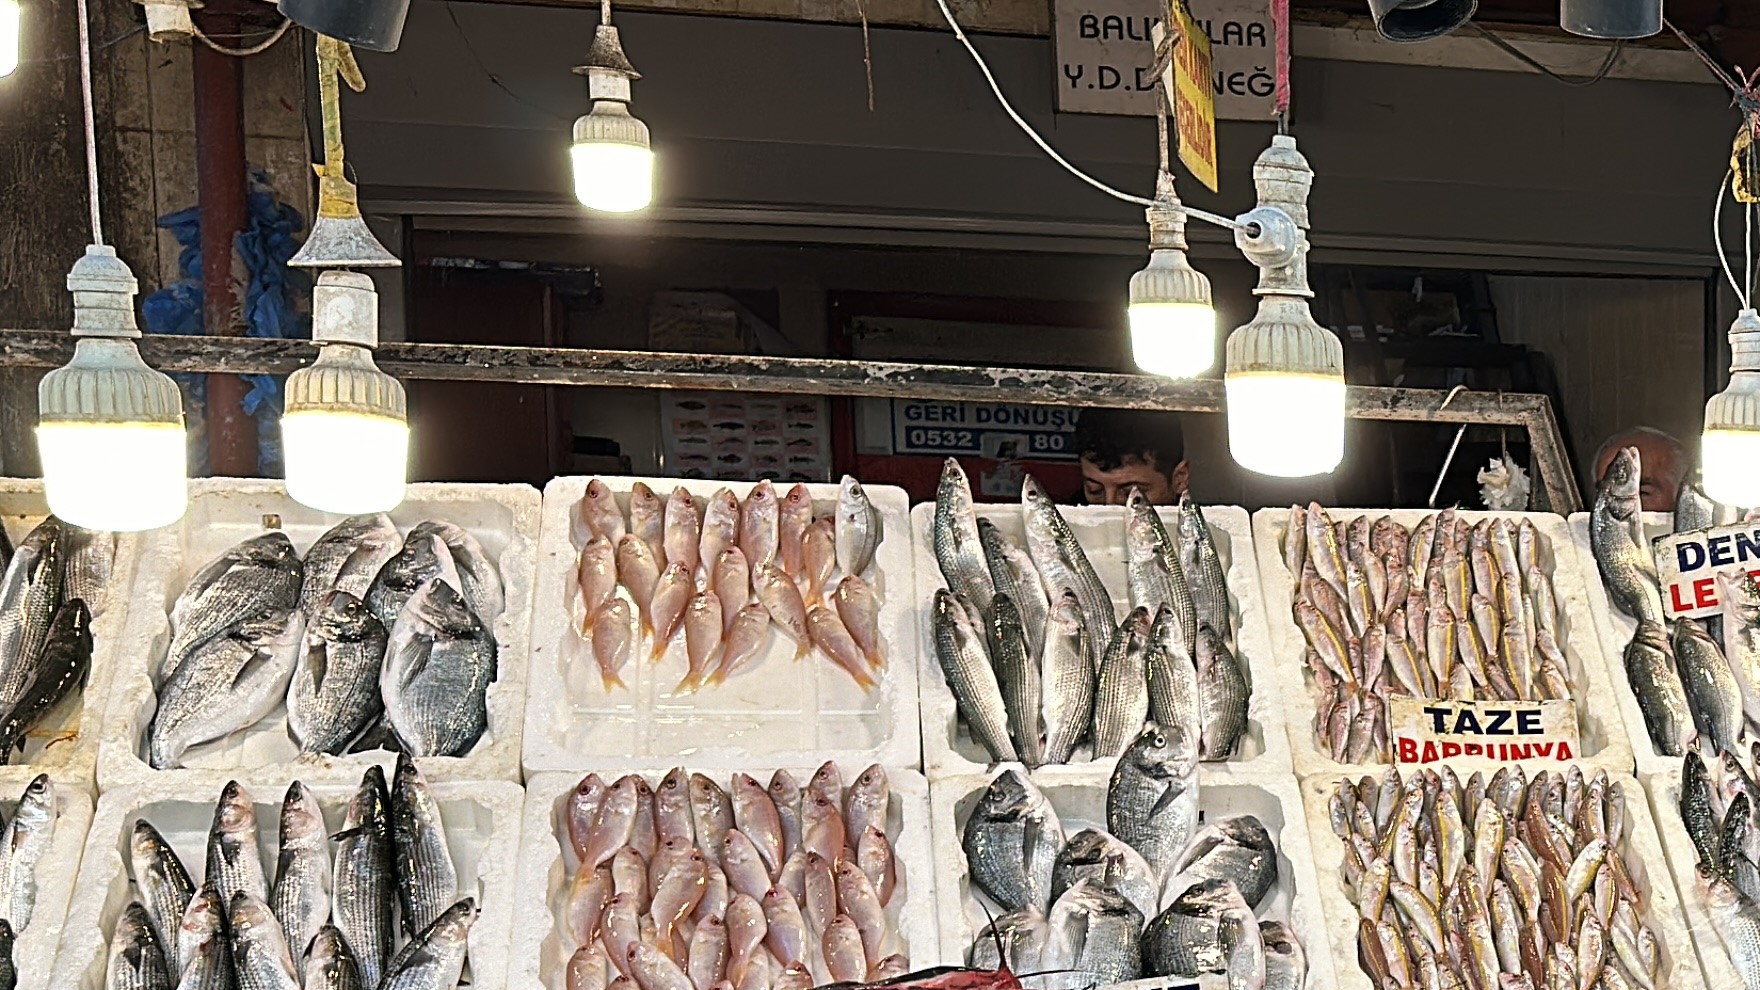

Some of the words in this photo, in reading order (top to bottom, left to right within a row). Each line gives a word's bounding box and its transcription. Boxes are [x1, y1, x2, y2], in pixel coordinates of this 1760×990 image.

[1080, 14, 1266, 47] BALILAR
[905, 403, 966, 423] GERİ
[911, 429, 973, 447] 0532
[1034, 433, 1064, 450] 80
[1424, 707, 1545, 736] TAZE
